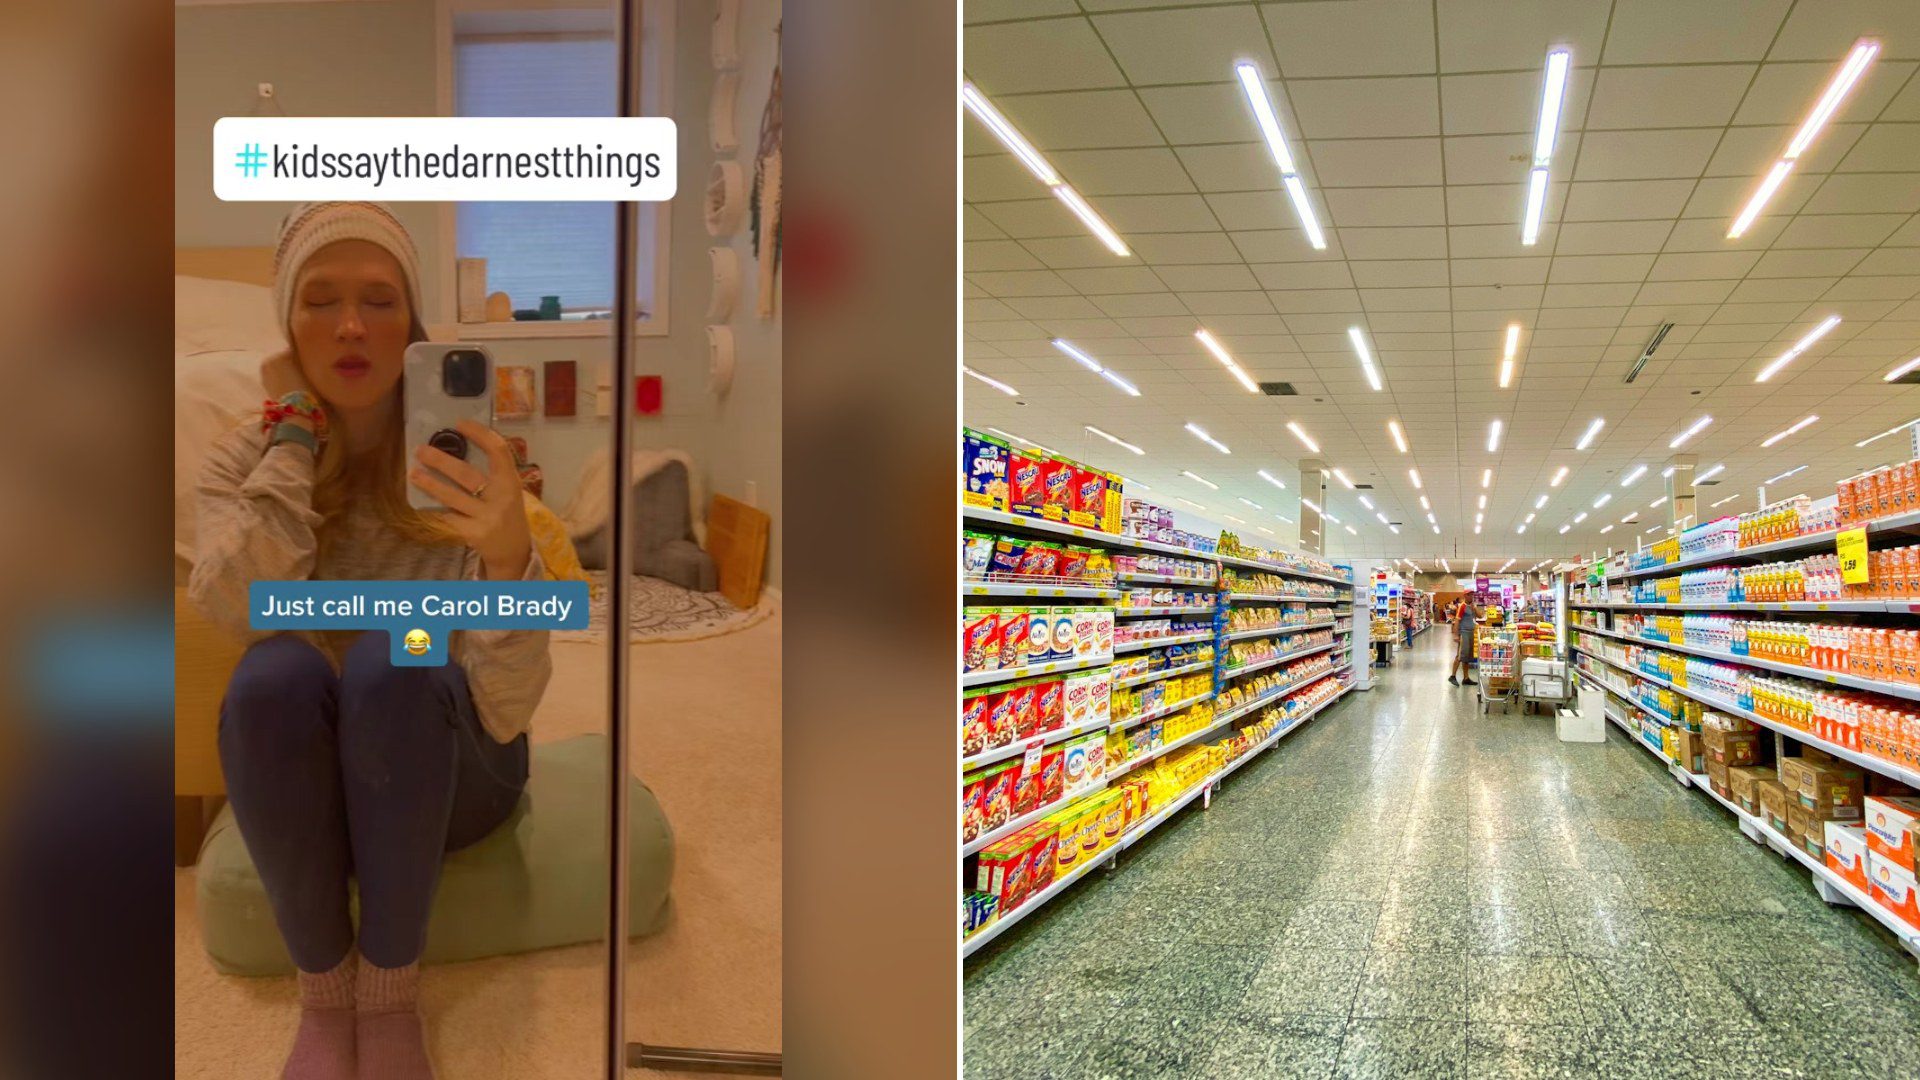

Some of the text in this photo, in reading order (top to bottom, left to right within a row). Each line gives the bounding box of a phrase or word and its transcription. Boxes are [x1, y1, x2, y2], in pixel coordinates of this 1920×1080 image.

[972, 457, 1007, 476] SNOW
[1068, 685, 1087, 701] CORN
[1091, 682, 1108, 696] CORN
[963, 701, 985, 727] ESCAU
